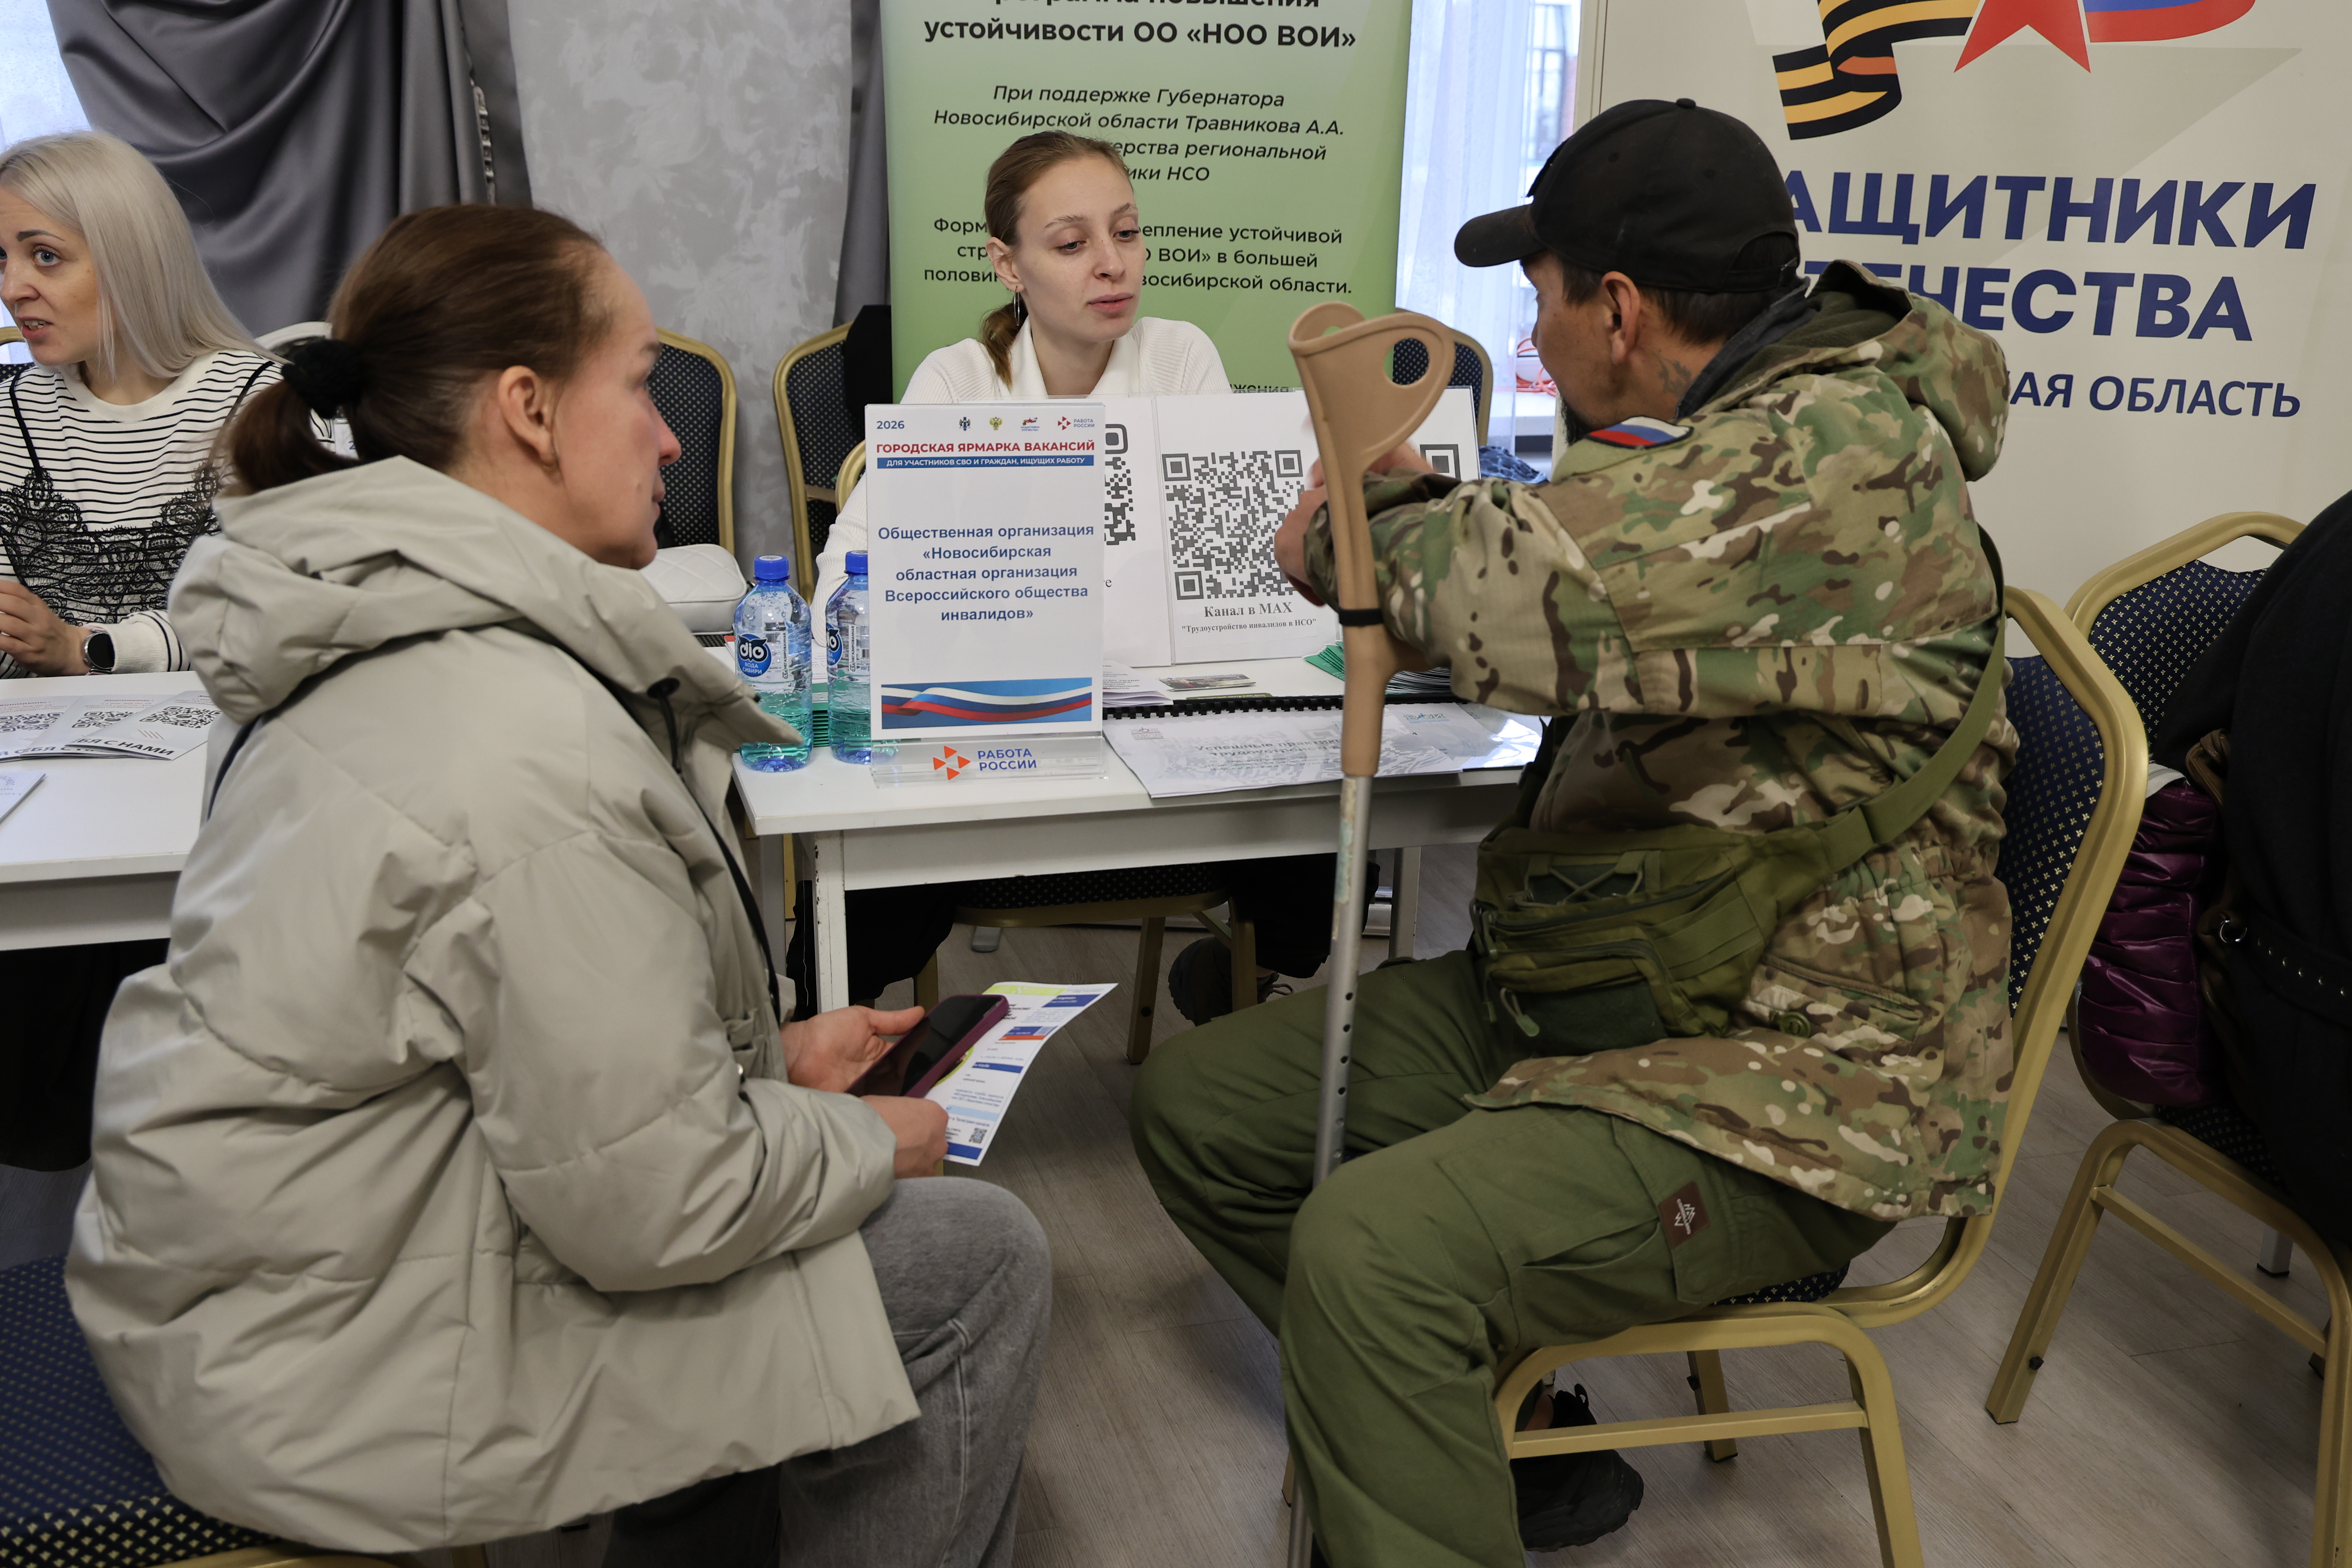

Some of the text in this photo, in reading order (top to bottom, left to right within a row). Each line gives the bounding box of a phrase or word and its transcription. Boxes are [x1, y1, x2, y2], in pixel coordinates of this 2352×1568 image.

[924, 17, 1356, 47] устойчивости ОО «НОО ВОИ»
[993, 85, 1285, 109] При поддержке Губернатора
[934, 110, 1344, 135] Новосибирской области Травникова А.А.
[1114, 142, 1327, 160] ерства региональной
[1167, 166, 1210, 181] НСО
[1784, 170, 2316, 249] АЩИТНИКИ
[1139, 225, 1223, 238] епление
[1229, 227, 1342, 243] устойчивой
[1159, 248, 1210, 263] ВОИ»
[1218, 252, 1227, 263] в
[1234, 250, 1318, 268] большей
[1142, 273, 1263, 290] восибирской
[1270, 277, 1352, 294] области.
[2089, 376, 2301, 418] ОБЛАСТЬ
[877, 420, 905, 429] 2026
[877, 439, 1095, 454] ГОРОДСКАЯ ЯРМАРКА ВАКАНСИЙ
[878, 524, 1094, 540] Общественная организация
[923, 546, 1051, 561] «Новосибирская
[896, 566, 1078, 581] областная организация
[885, 586, 1089, 603] Всероссийского общества
[941, 608, 1034, 622] инвалидов»
[1204, 605, 1244, 617] Канал
[1182, 623, 1247, 633] "Трудоустройство
[740, 642, 764, 659] dio
[118, 741, 175, 756] НАМИ
[978, 748, 1032, 759] РАБОТА
[979, 759, 1037, 771] РОССИИ
